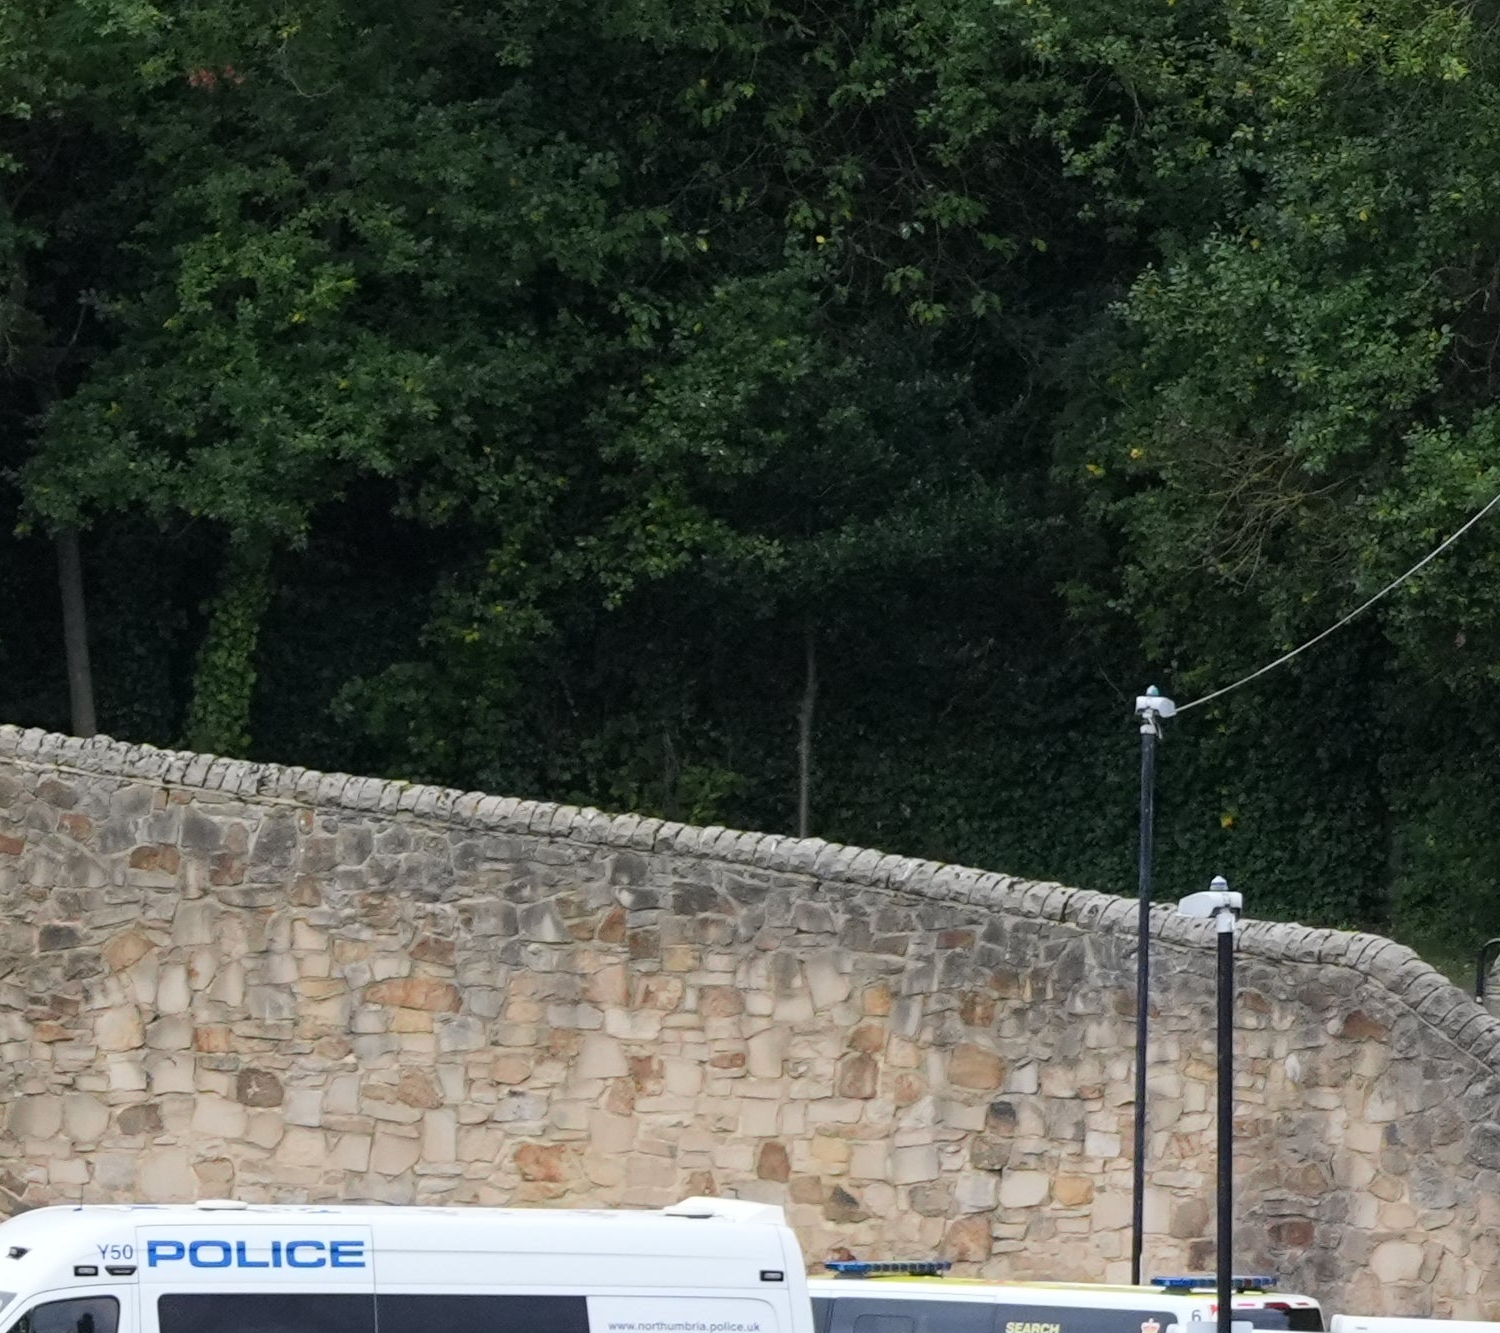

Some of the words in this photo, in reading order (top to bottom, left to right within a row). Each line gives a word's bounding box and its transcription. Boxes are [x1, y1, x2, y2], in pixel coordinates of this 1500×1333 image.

[96, 1243, 134, 1260] Y50
[147, 1240, 366, 1268] POLICE
[608, 1321, 761, 1333] www.northumbria.police.uk
